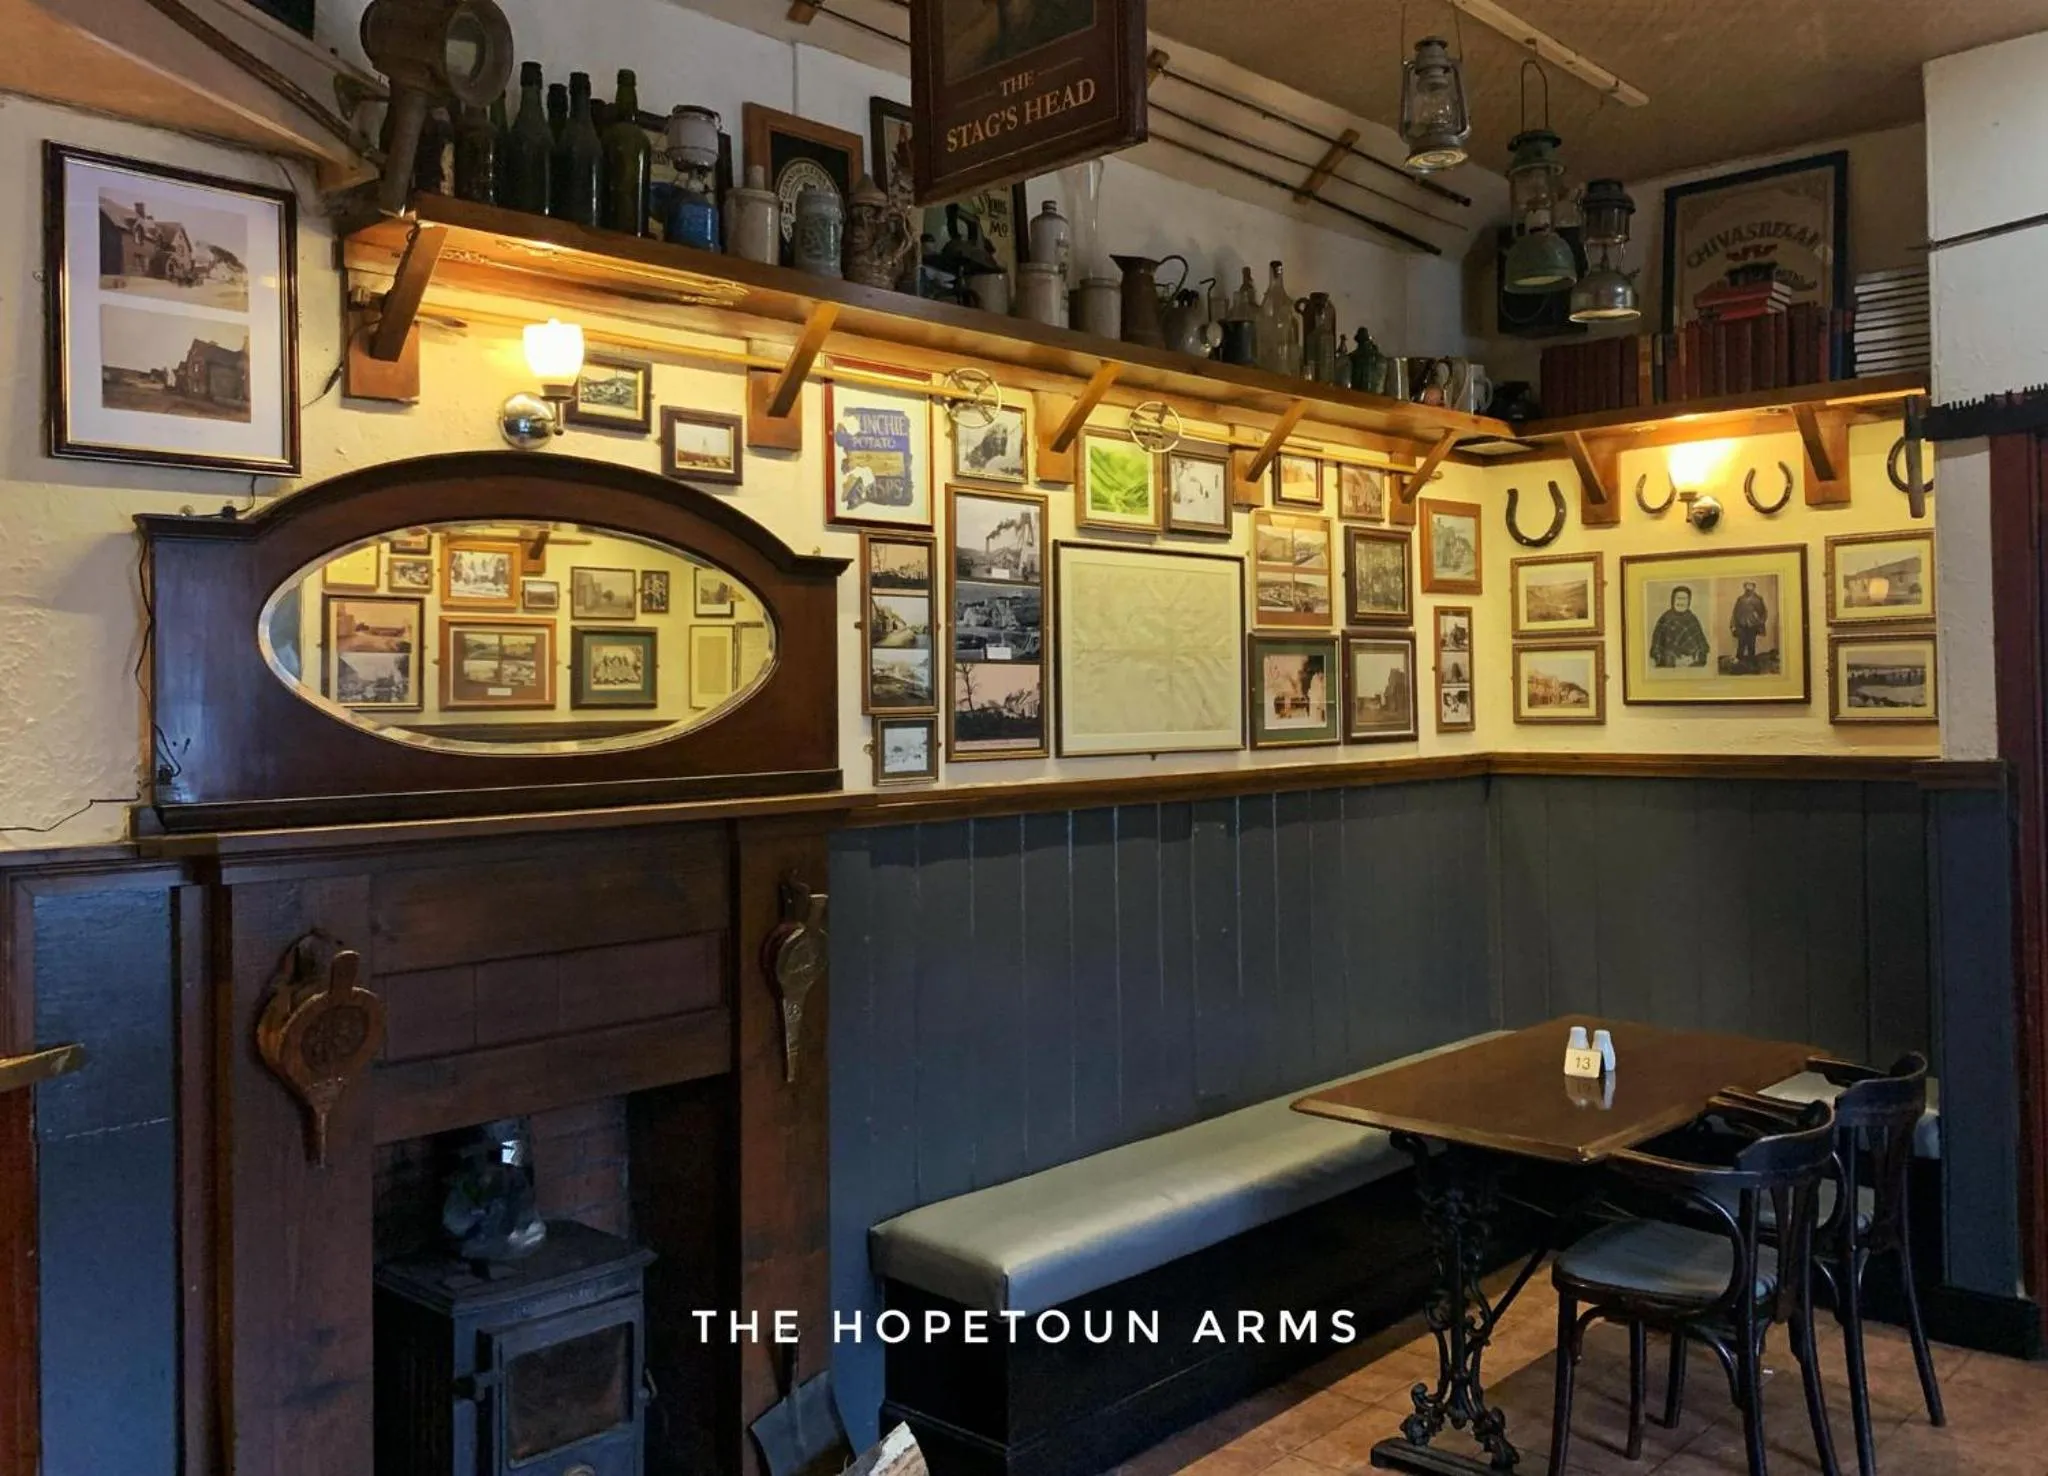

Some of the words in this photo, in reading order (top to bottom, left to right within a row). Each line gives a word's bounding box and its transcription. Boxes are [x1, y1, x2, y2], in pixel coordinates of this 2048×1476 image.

[999, 70, 1035, 97] THE
[946, 105, 1018, 153] STAG'S
[1024, 78, 1096, 125] HEAD
[852, 435, 897, 449] POTATO
[1575, 1057, 1591, 1070] 13
